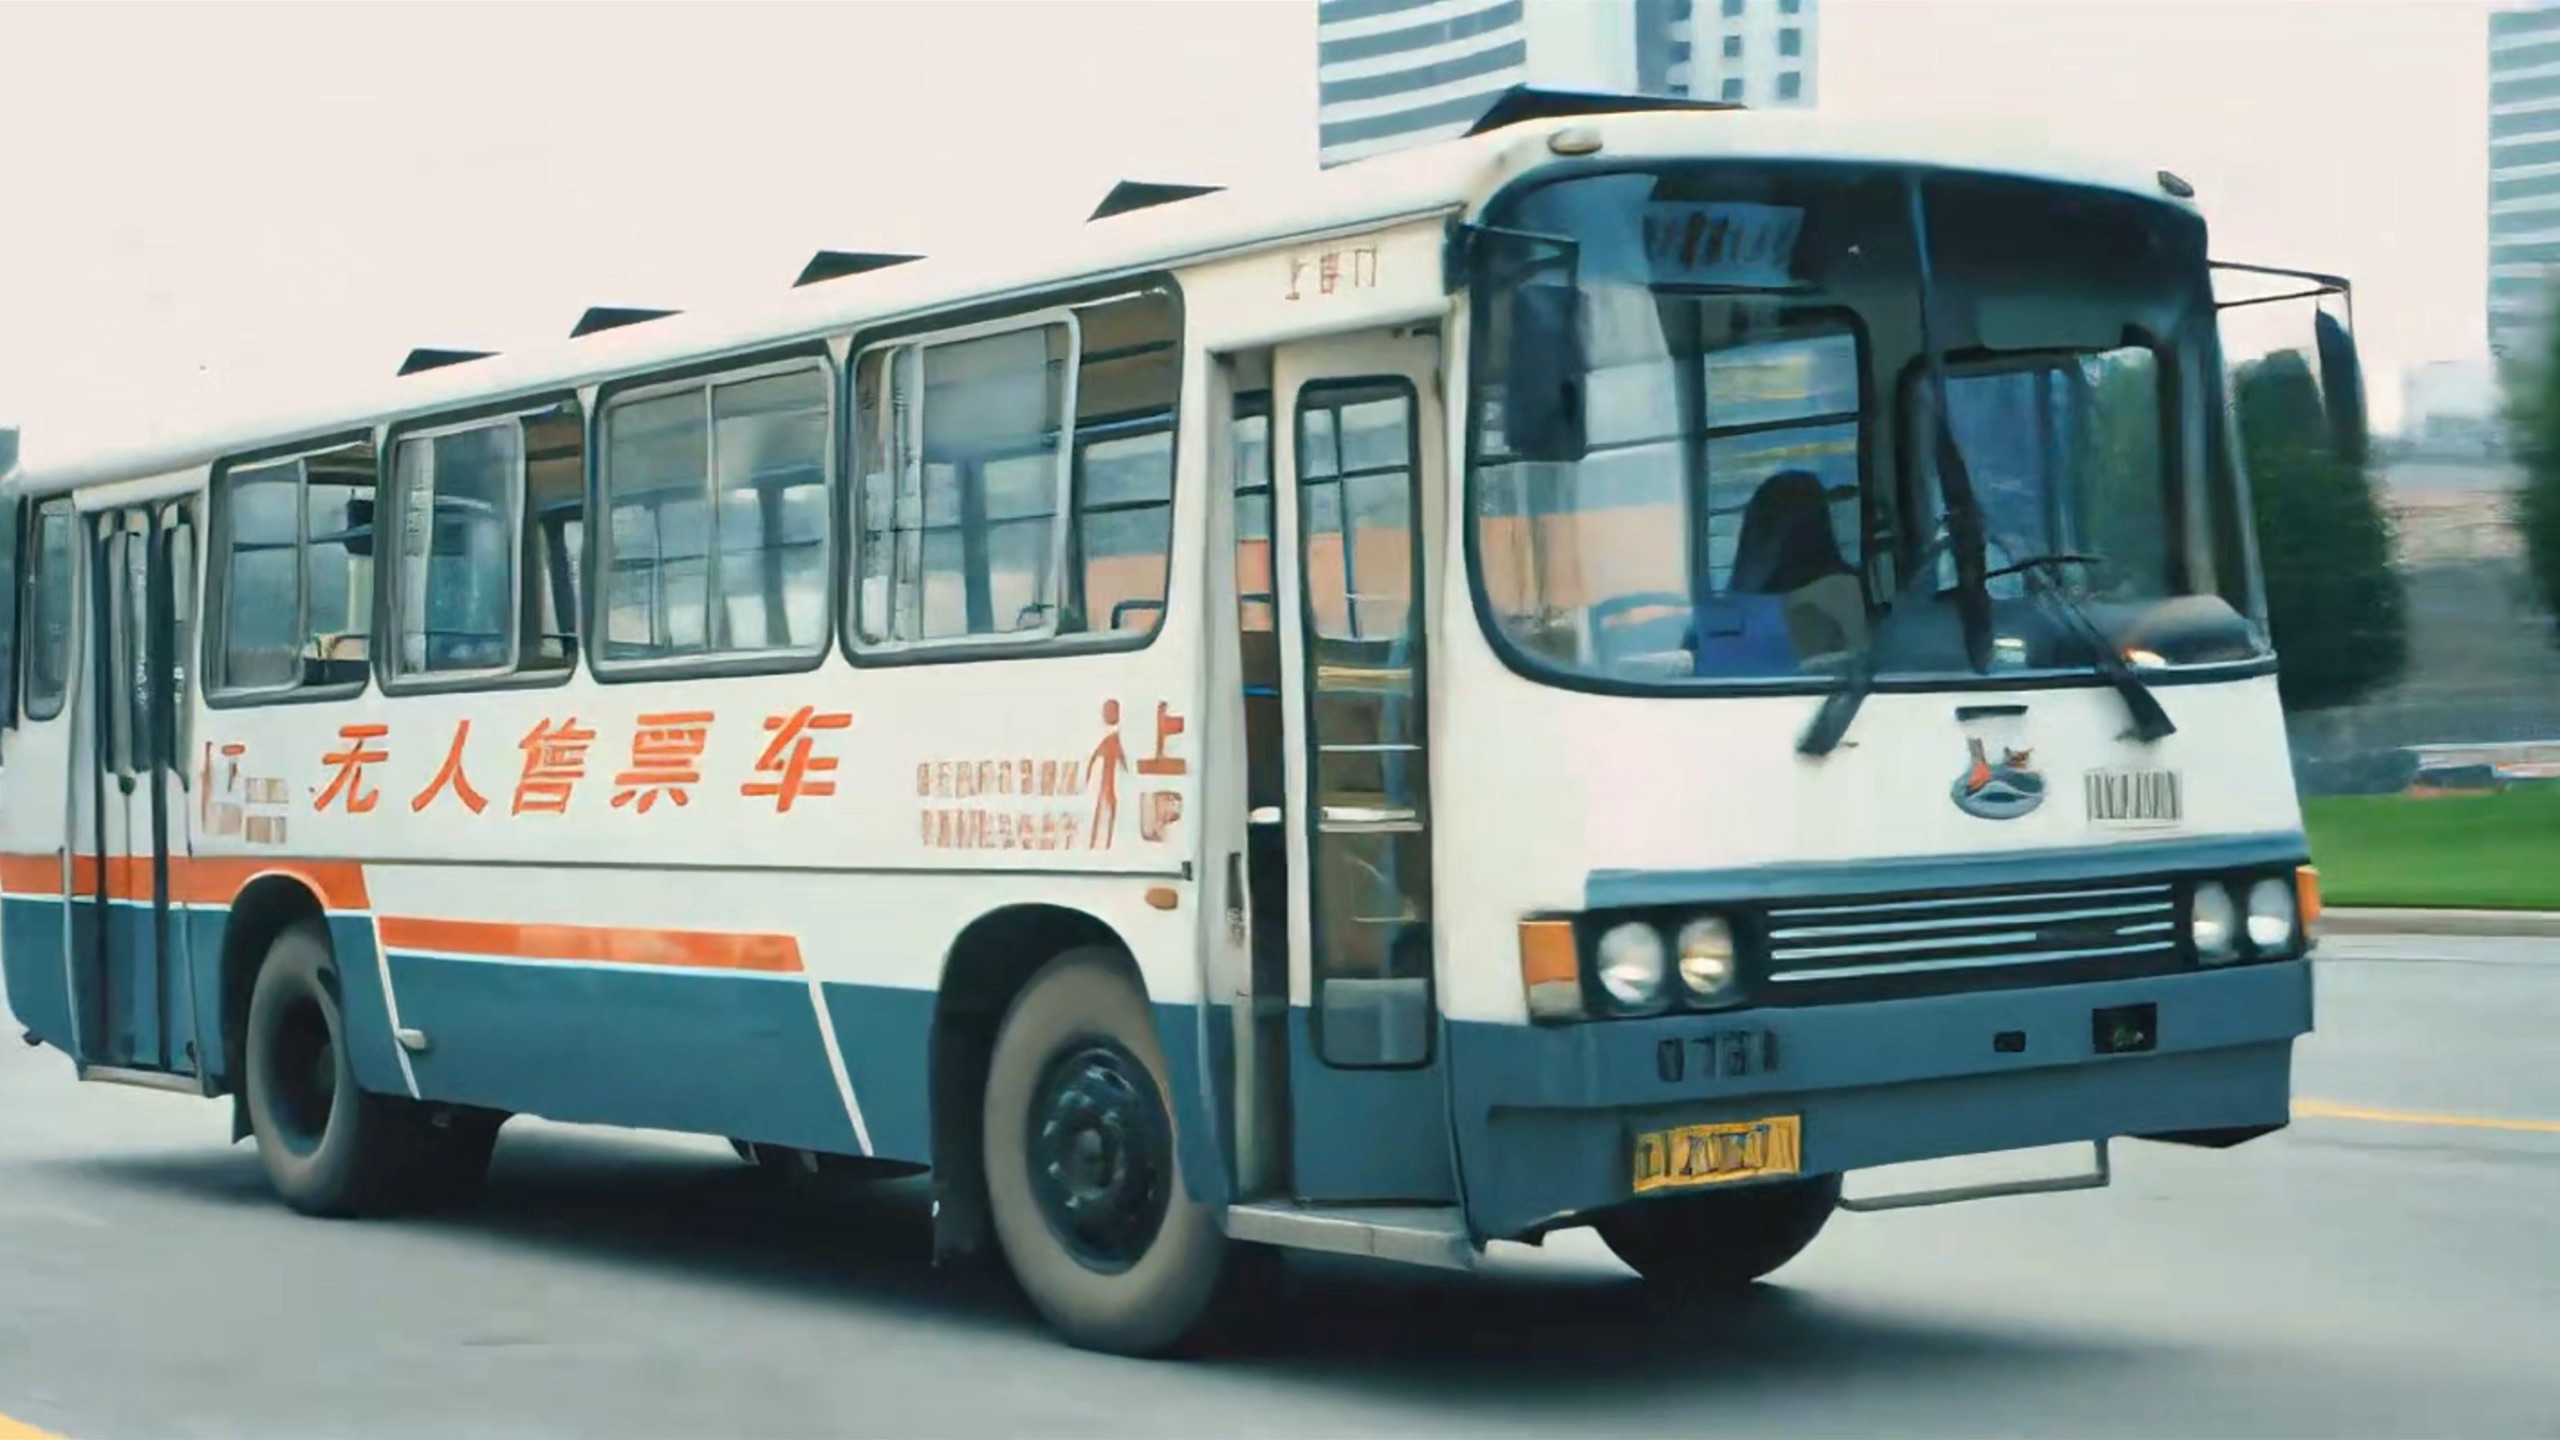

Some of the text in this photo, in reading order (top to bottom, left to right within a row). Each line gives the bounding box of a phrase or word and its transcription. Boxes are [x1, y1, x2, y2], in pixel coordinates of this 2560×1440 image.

[313, 705, 853, 815] 无人售票车
[1137, 701, 1186, 775] 上
